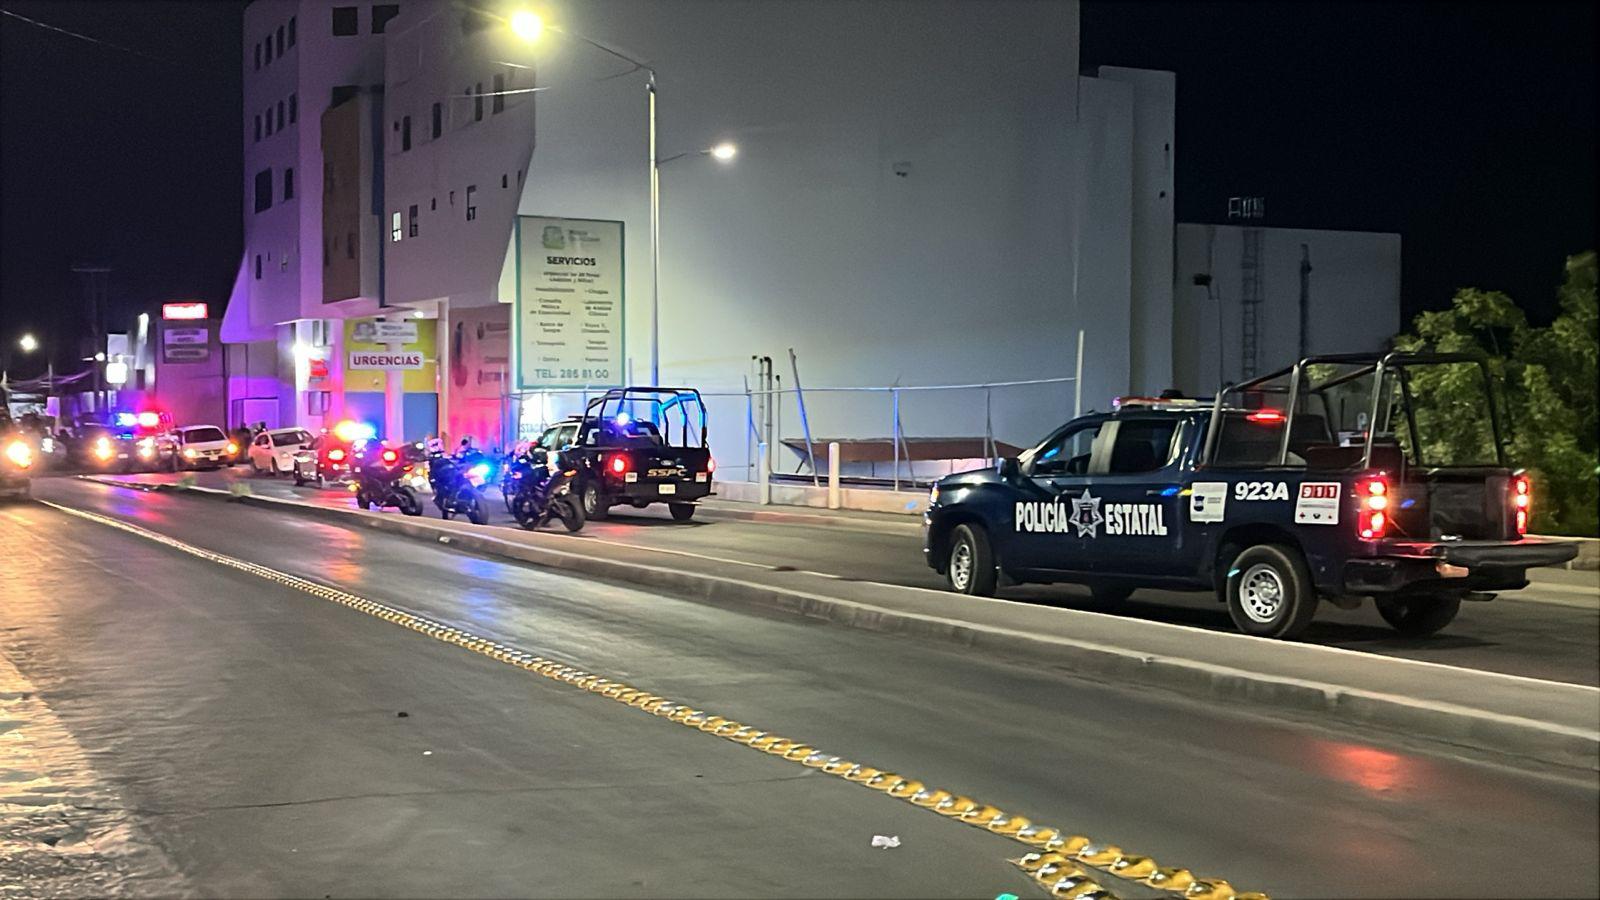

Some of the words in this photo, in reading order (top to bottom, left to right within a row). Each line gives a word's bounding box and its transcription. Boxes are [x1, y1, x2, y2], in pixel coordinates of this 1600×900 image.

[546, 256, 596, 266] SERVICIOS
[353, 355, 420, 366] URGENCIAS
[534, 368, 557, 378] TEL.
[647, 468, 688, 477] SSPC
[1235, 482, 1289, 501] 923A
[1302, 485, 1338, 498] 911
[1016, 496, 1069, 533] POLICÍA
[1105, 504, 1168, 536] ESTATAL
